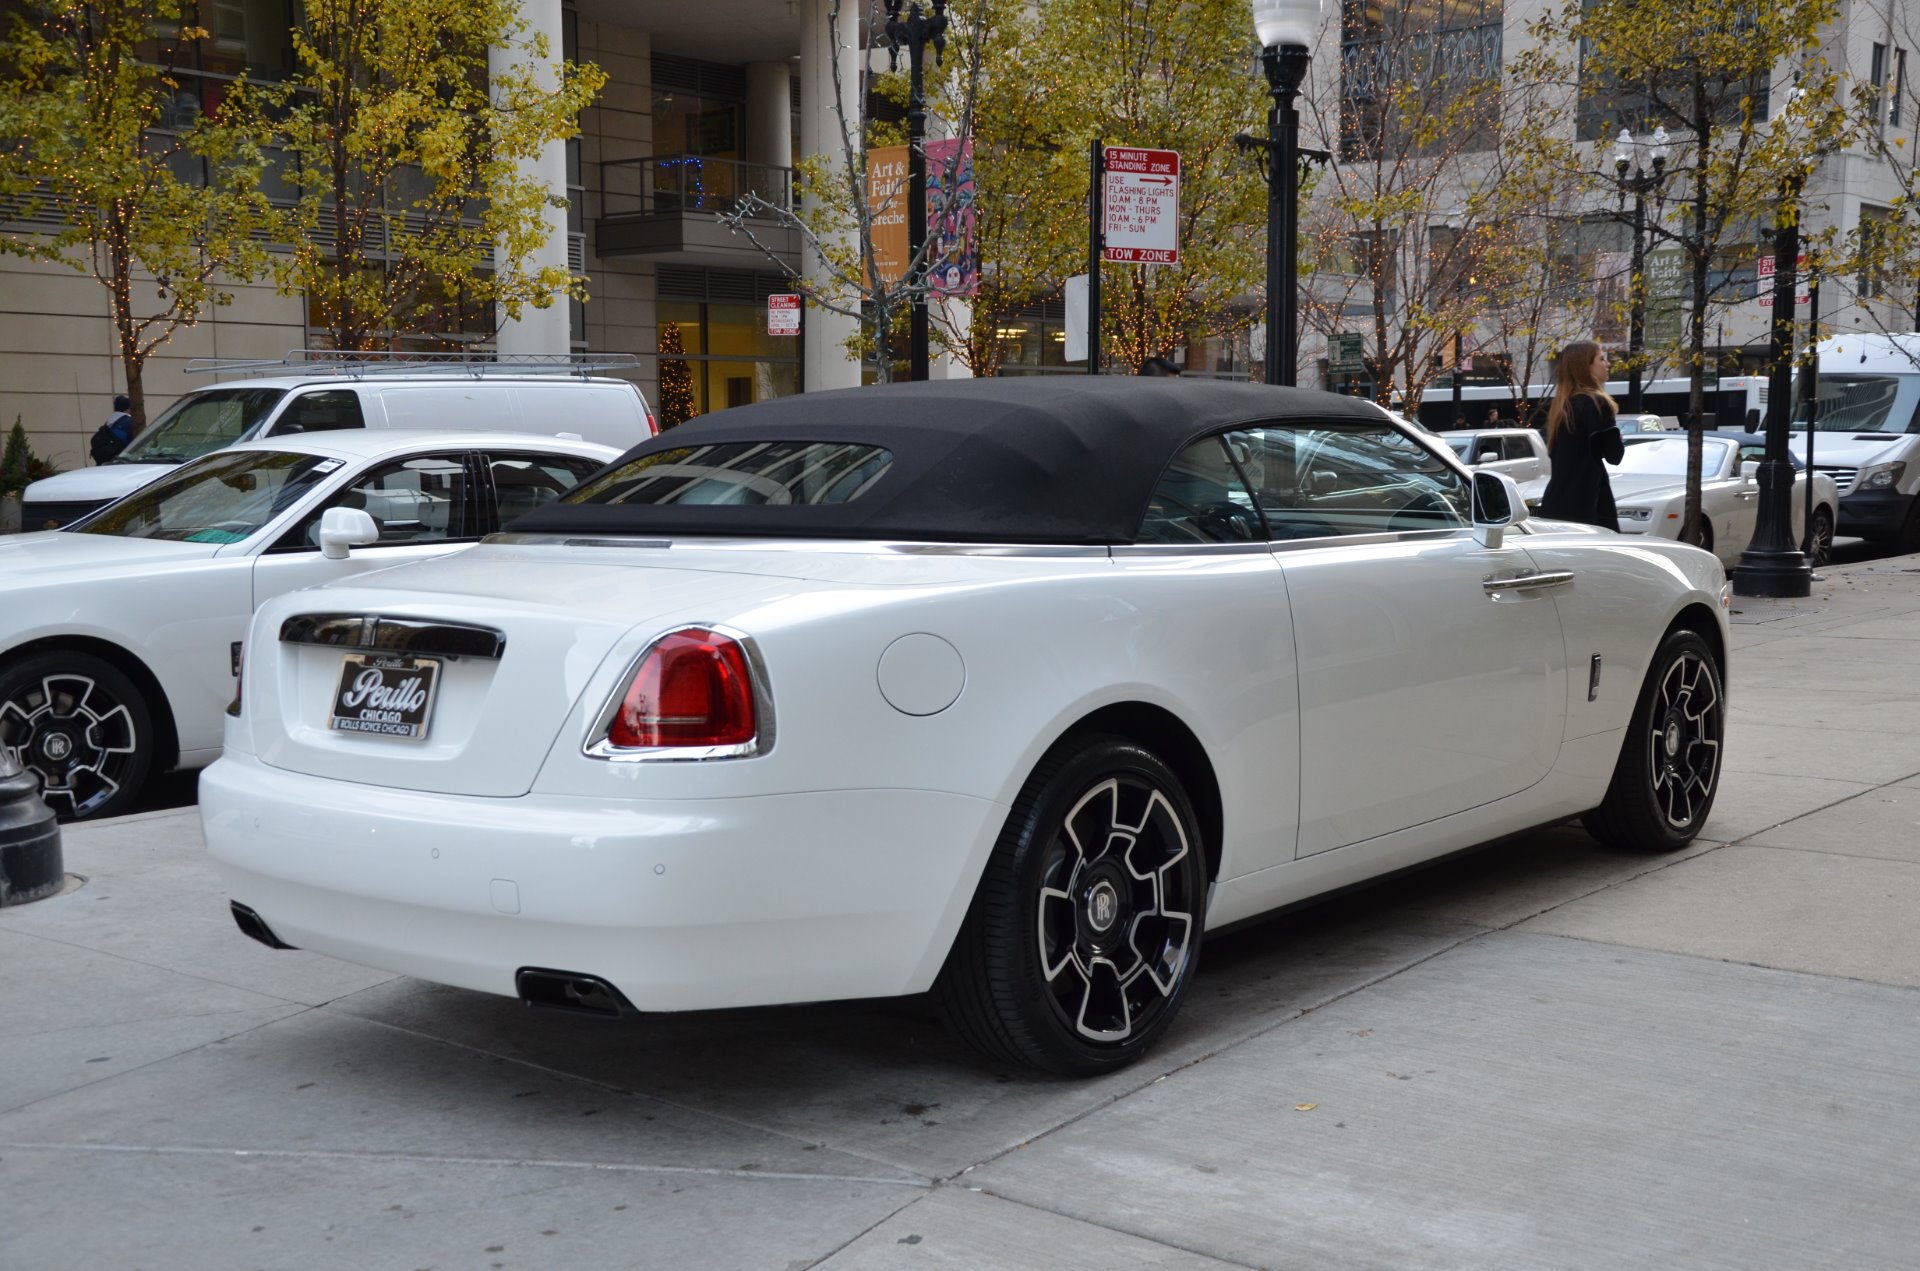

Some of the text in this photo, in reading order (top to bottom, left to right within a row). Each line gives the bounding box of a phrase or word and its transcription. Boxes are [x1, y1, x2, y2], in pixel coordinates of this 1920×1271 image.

[1109, 151, 1148, 161] 15 MINUTE
[872, 161, 905, 178] Art &
[1109, 161, 1171, 172] STANDING ZONE
[1109, 176, 1124, 184] USE
[871, 178, 903, 197] Faith
[1109, 185, 1174, 197] FLASHING LIGHTS
[1109, 205, 1126, 213] MON
[1135, 206, 1161, 215] THURS
[1108, 223, 1121, 231] FRI
[1129, 224, 1145, 233] SUN
[1108, 248, 1171, 262] TOW ZONE
[1650, 255, 1681, 267] Art &
[1651, 266, 1680, 278] Faith
[342, 668, 426, 713] Perillo
[360, 709, 402, 723] CHICAGO
[340, 720, 409, 734] ROLLS ROYCE CHICAGO
